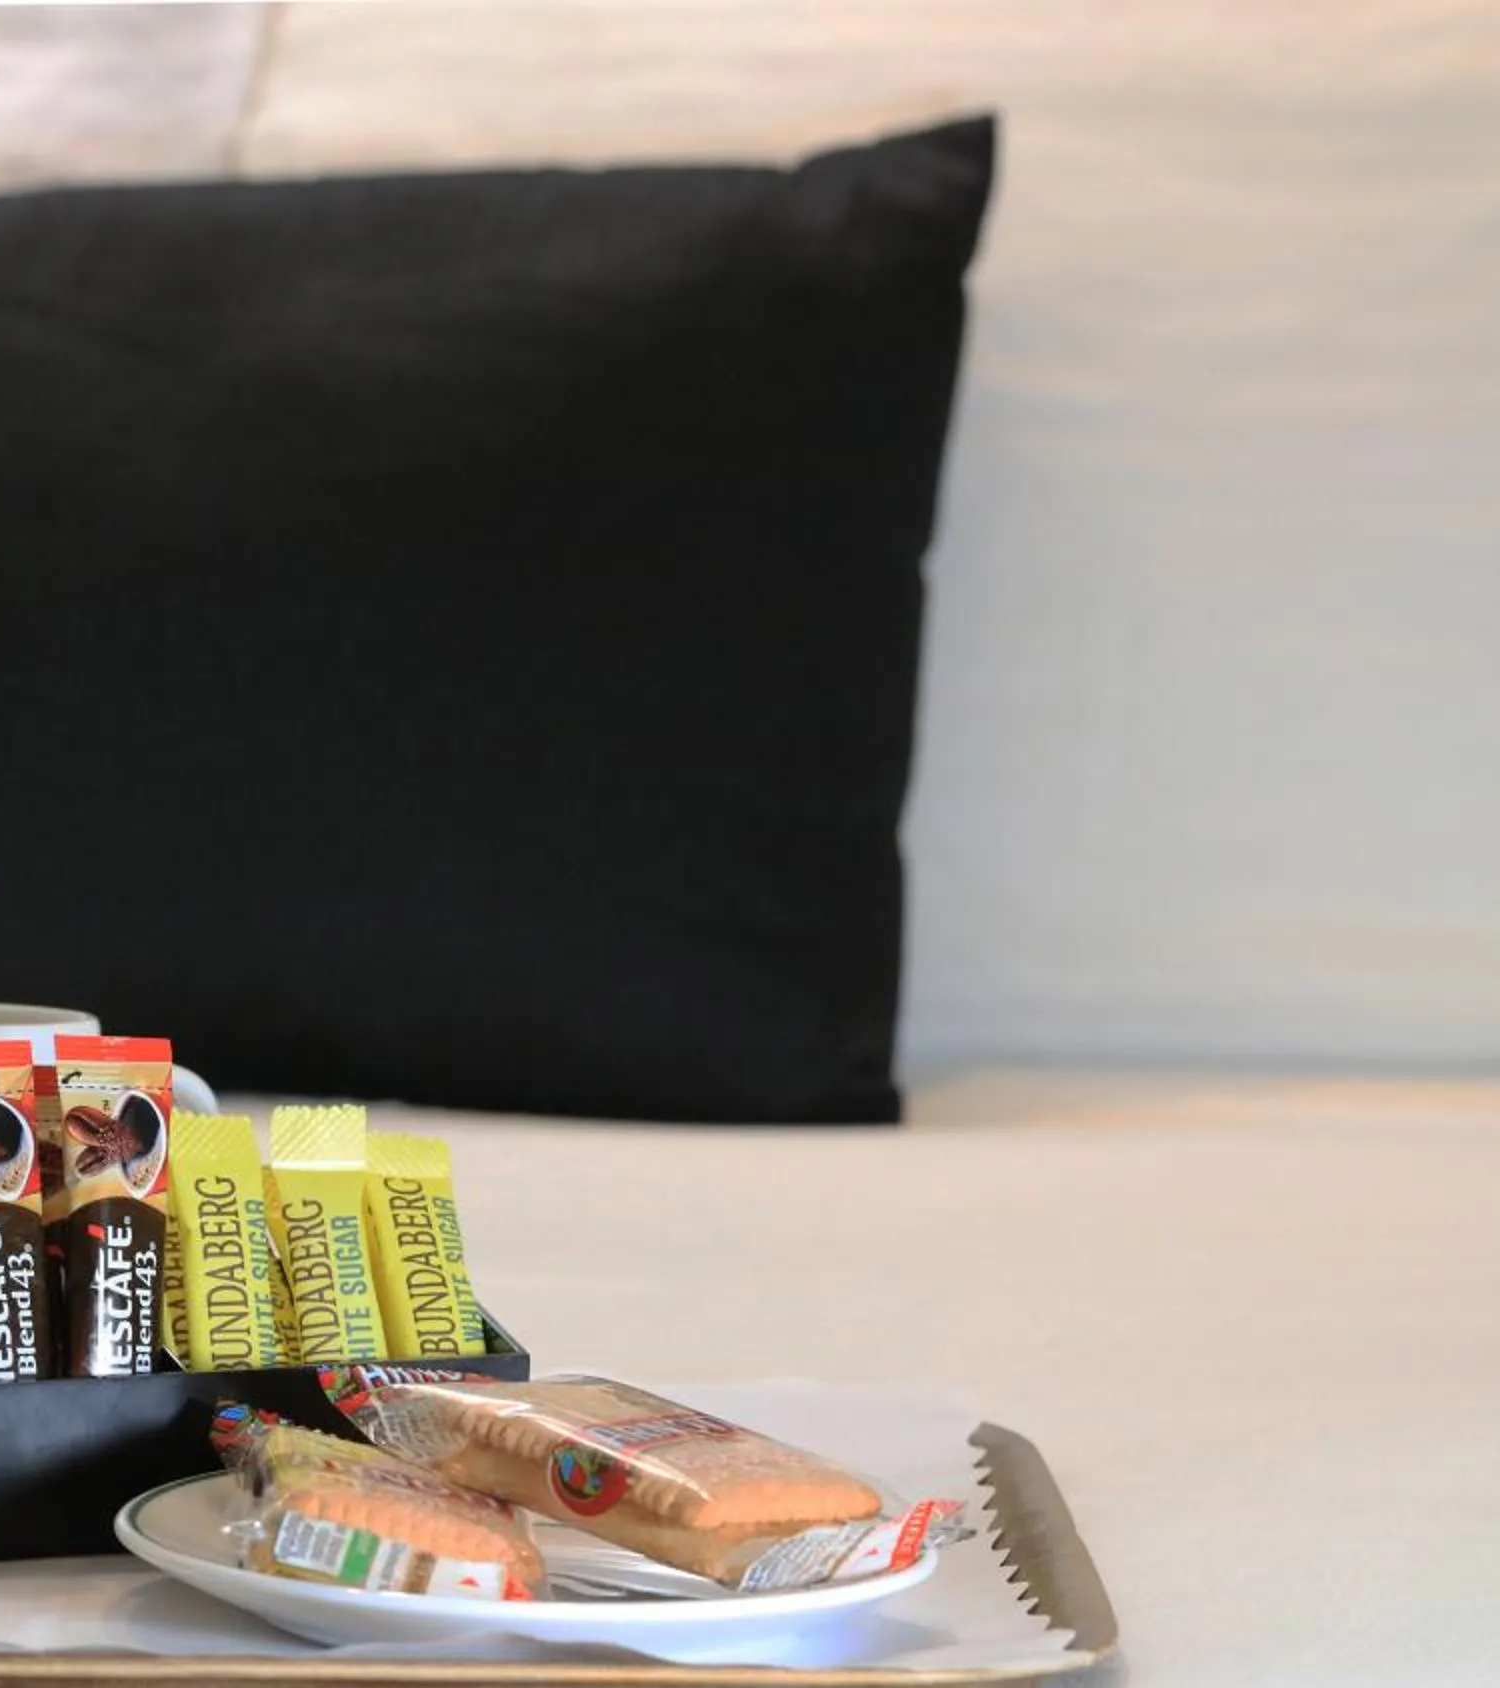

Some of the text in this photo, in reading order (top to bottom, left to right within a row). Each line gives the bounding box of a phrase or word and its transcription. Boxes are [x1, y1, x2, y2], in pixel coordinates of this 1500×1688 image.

[245, 1199, 269, 1280] SUGAR
[282, 1200, 342, 1363] NDABERG
[331, 1216, 375, 1361] HITE SUGAR
[383, 1176, 460, 1355] BUNDABERG
[432, 1196, 483, 1343] WHITE SUGAR
[11, 1291, 37, 1375] Blend
[134, 1288, 152, 1373] Blend
